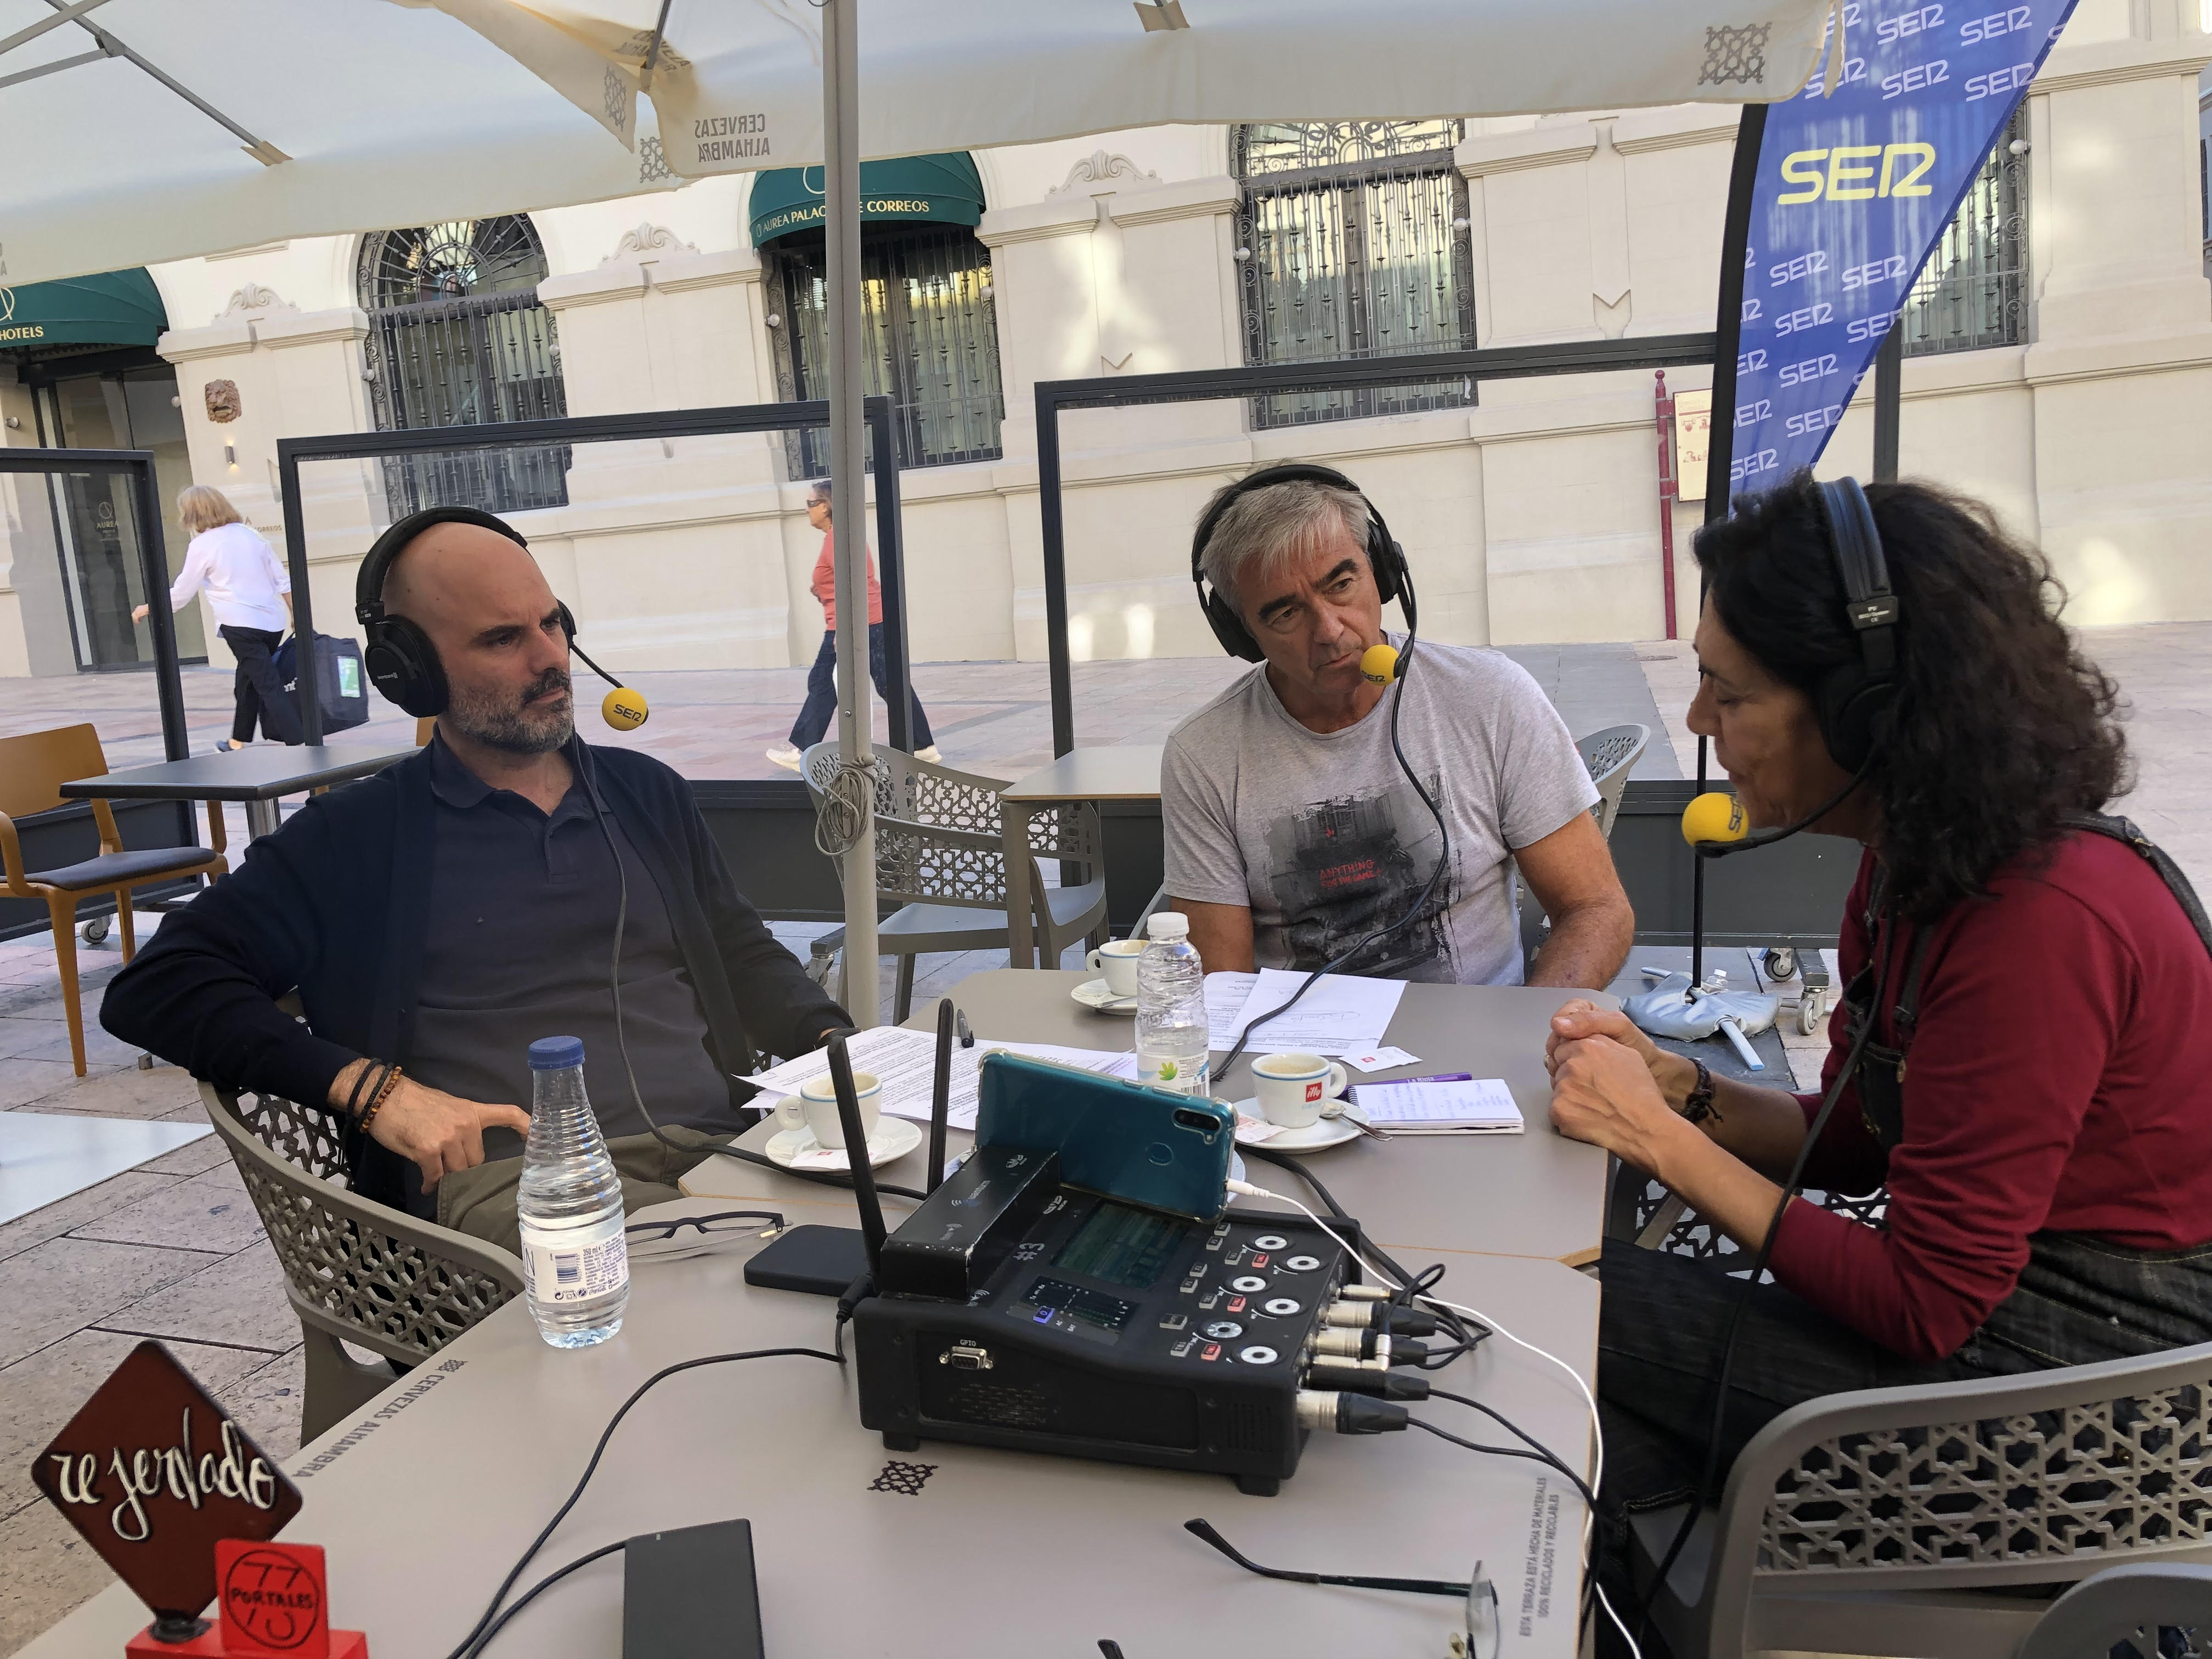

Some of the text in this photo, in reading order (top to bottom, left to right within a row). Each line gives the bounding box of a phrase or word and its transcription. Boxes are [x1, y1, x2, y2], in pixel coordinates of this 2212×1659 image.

[1876, 3, 1945, 45] SER
[1960, 5, 2033, 46] SER
[1804, 57, 1867, 99] SR
[1881, 59, 1950, 100] SER
[1965, 62, 2035, 101] SER
[1778, 142, 1936, 205] SER
[762, 213, 789, 233] AUREA
[791, 205, 826, 224] PALAC
[866, 200, 930, 212] CORREOS
[1769, 250, 1829, 287] SER
[1842, 255, 1908, 292] SER
[1775, 302, 1833, 338] SER
[1779, 353, 1839, 388] SER
[1733, 399, 1773, 429] ER
[1786, 404, 1843, 438] SER
[1730, 448, 1779, 481] SER
[613, 703, 642, 722] SER
[1319, 859, 1374, 880] ANYTHING
[583, 1246, 598, 1256] 350 ml
[1013, 1243, 1045, 1261] #3
[292, 1374, 445, 1477] CERVEZAS ALHAMBRA
[231, 1588, 313, 1609] PORTALES
